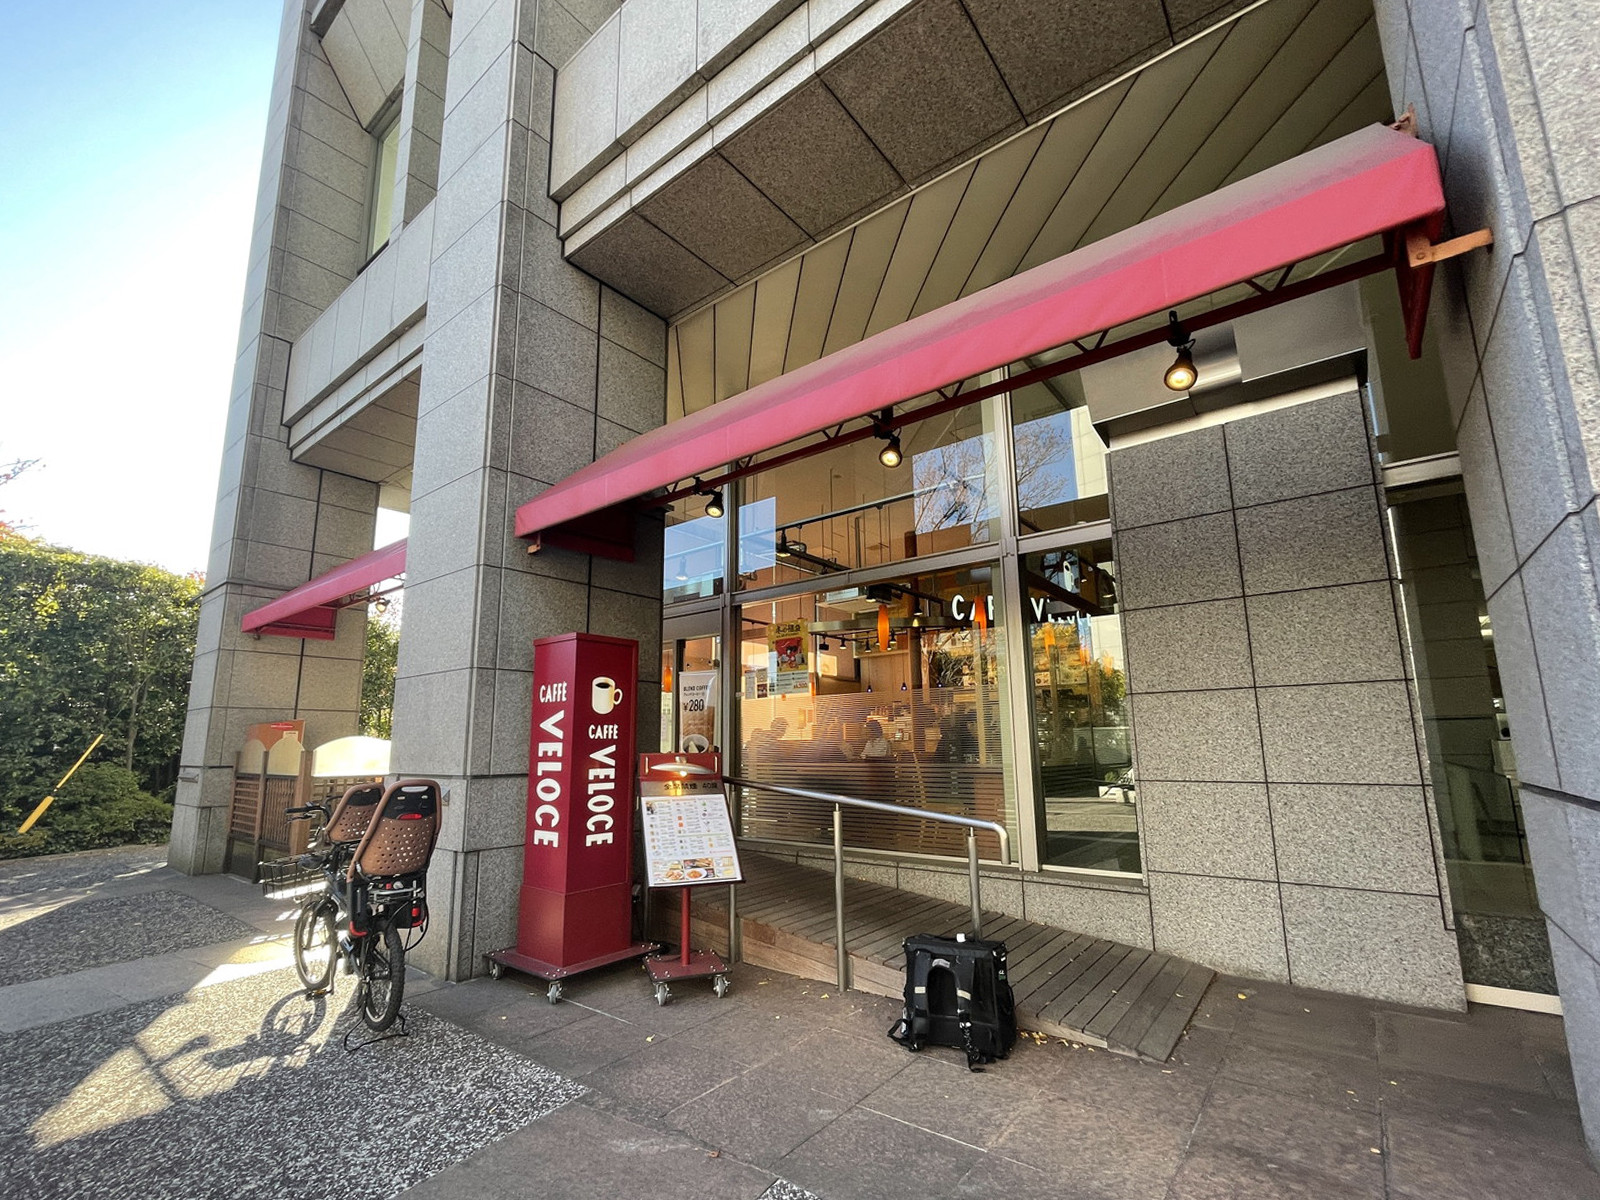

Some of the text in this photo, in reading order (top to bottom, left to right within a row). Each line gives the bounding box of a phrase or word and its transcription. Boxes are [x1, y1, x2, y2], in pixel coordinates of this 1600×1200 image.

[683, 698, 705, 712] ¥280
[533, 709, 565, 848] VELOCE
[585, 744, 617, 847] VELOCE
